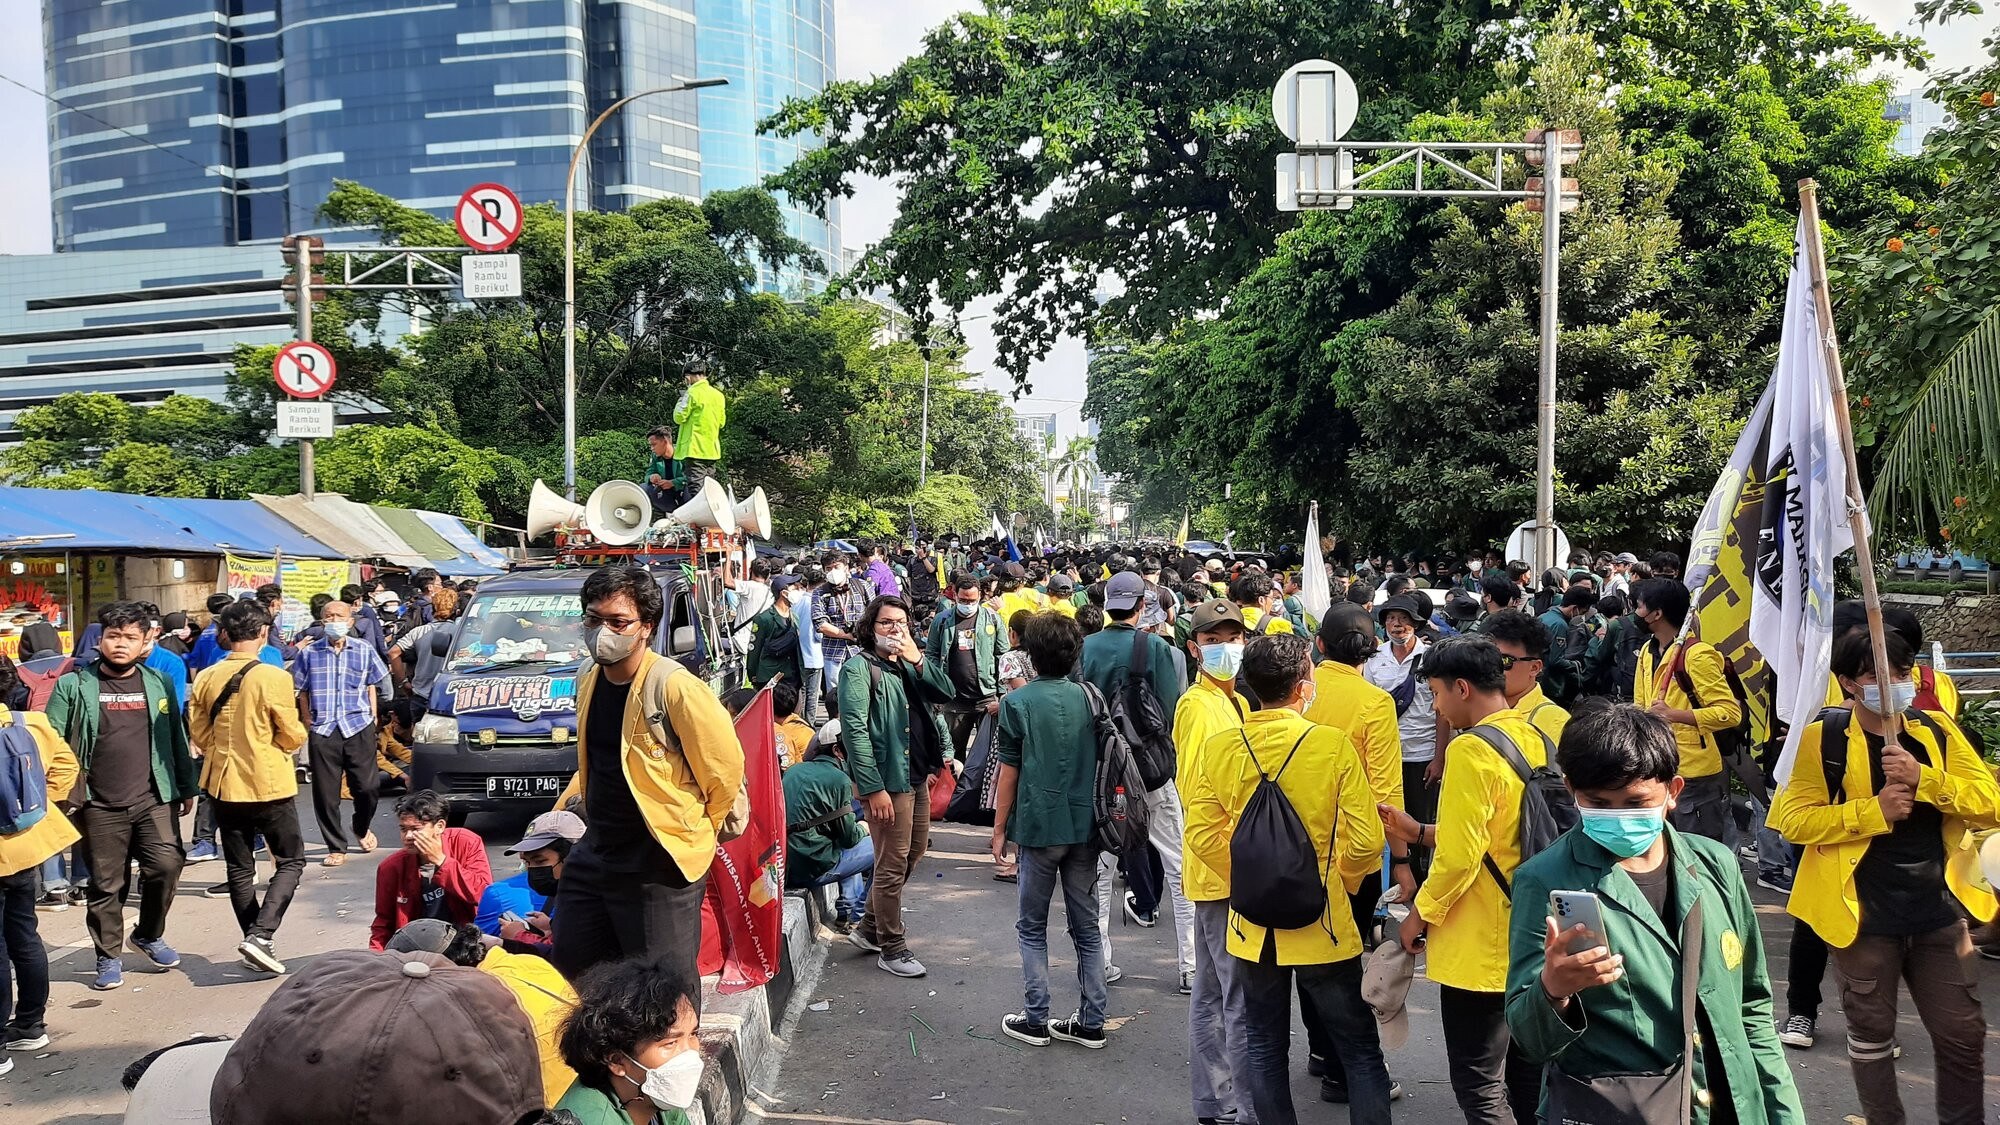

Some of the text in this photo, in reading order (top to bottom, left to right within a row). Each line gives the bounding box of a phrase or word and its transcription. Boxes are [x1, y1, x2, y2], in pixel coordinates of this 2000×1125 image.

[481, 199, 501, 237] P
[473, 257, 508, 270] Sampai
[474, 272, 507, 281] Rambu
[474, 283, 509, 293] Berikut
[297, 353, 315, 385] P
[288, 406, 320, 415] Sampai
[289, 415, 320, 423] Rambu
[489, 778, 556, 791] B 9721 PAG
[752, 936, 774, 979] AHMAD
